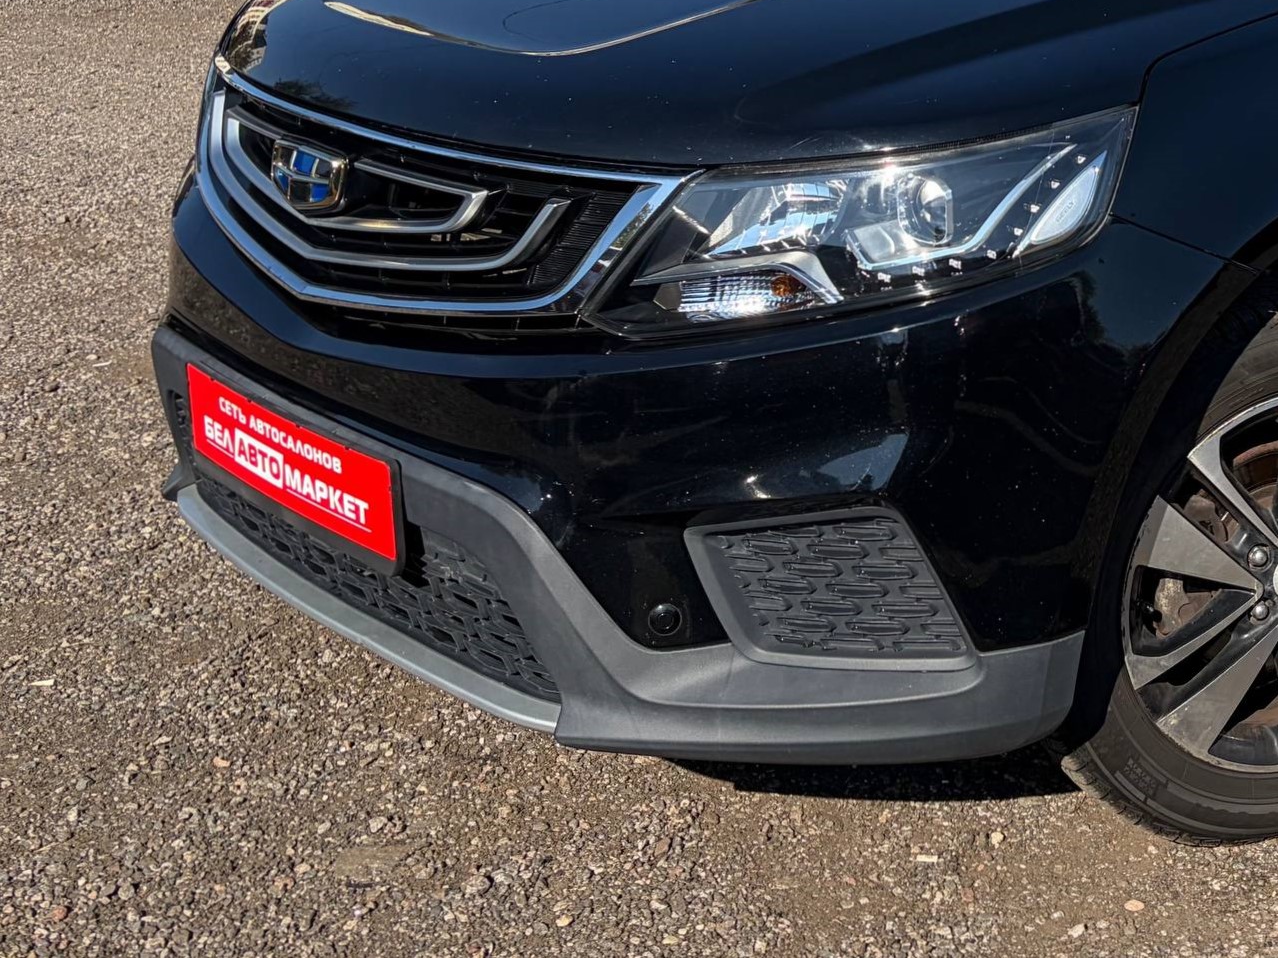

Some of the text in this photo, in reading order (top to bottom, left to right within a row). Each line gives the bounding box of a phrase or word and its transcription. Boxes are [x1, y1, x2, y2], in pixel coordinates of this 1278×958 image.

[203, 414, 370, 525] БЕЛ АВТО МАРКЕТ
[218, 396, 343, 475] СЕТЬ АВТОСАЛОНОВ
